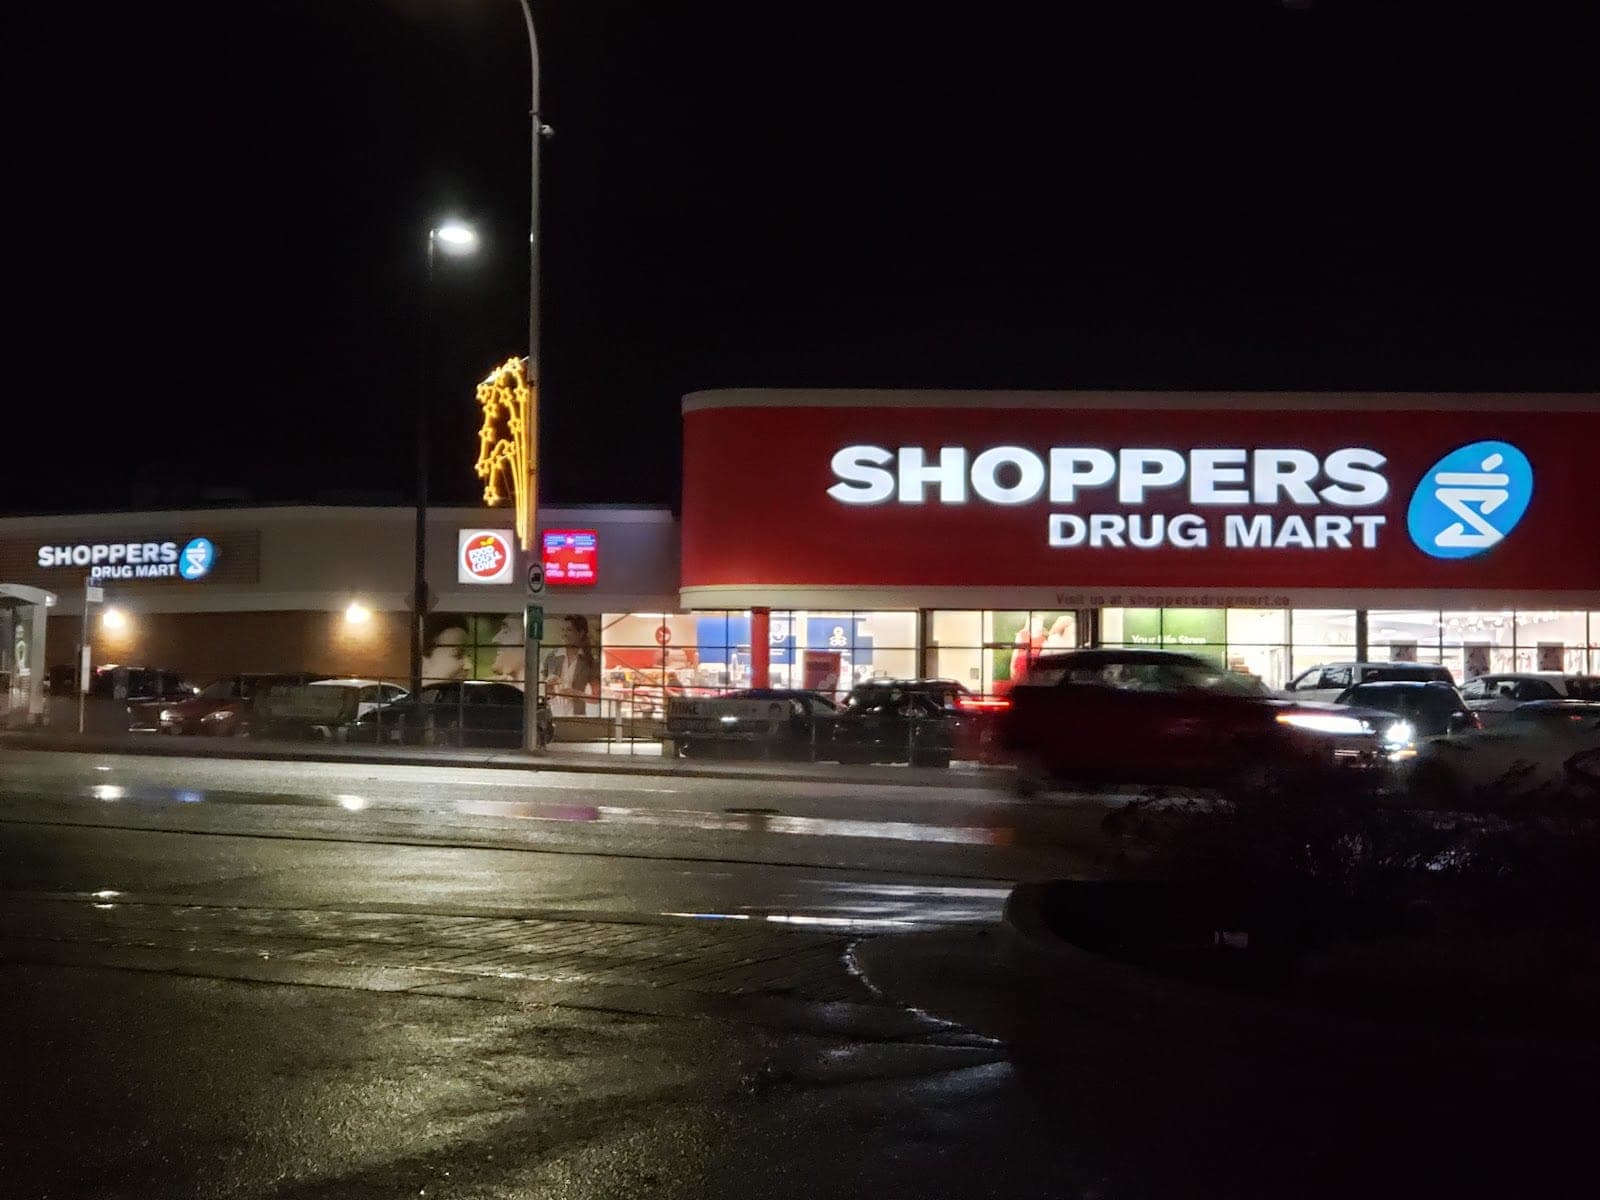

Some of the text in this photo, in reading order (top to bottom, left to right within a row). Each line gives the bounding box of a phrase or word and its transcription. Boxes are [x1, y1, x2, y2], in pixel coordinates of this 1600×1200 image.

[826, 445, 1389, 505] SHOPPERS
[1049, 513, 1386, 549] DRUG MART
[37, 541, 179, 567] SHOPPERS
[90, 563, 178, 579] DRUG MART
[1056, 591, 1290, 608] Visit us at shoppersdrugmart.ca
[1131, 634, 1157, 644] Your
